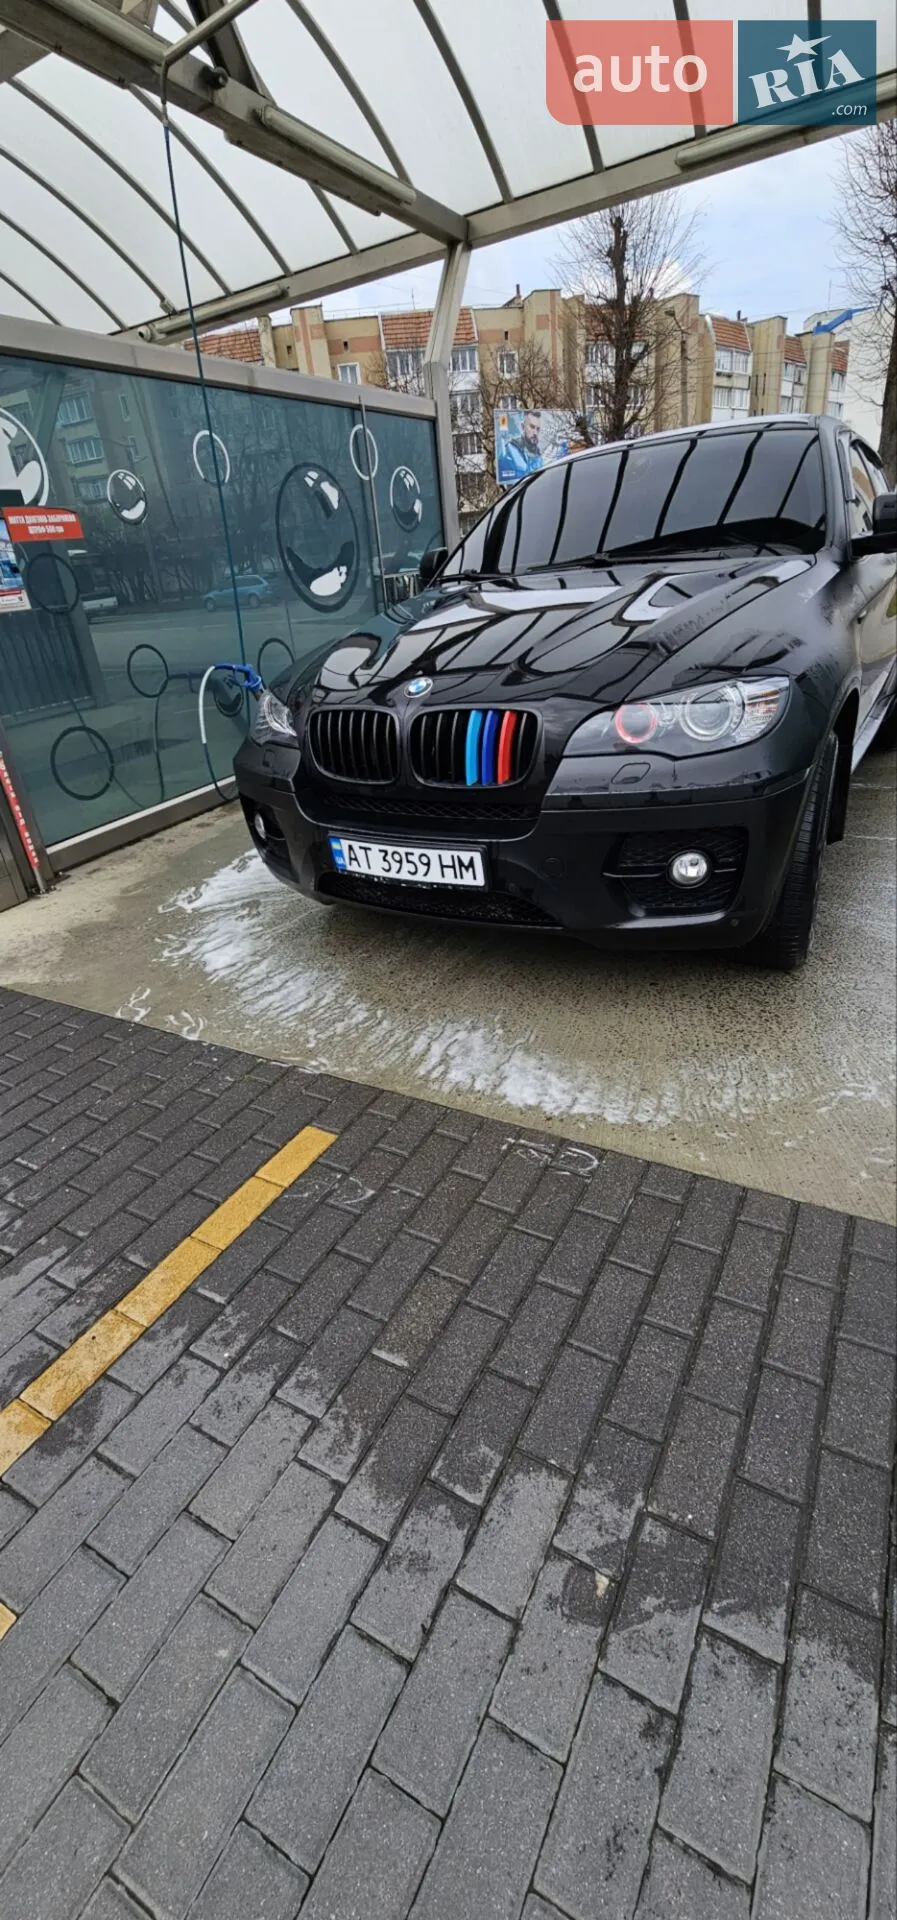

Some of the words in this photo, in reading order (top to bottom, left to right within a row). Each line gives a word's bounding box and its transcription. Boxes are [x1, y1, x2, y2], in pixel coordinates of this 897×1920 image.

[348, 844, 372, 870] AT
[378, 849, 431, 877] 3959
[438, 854, 477, 880] HM
